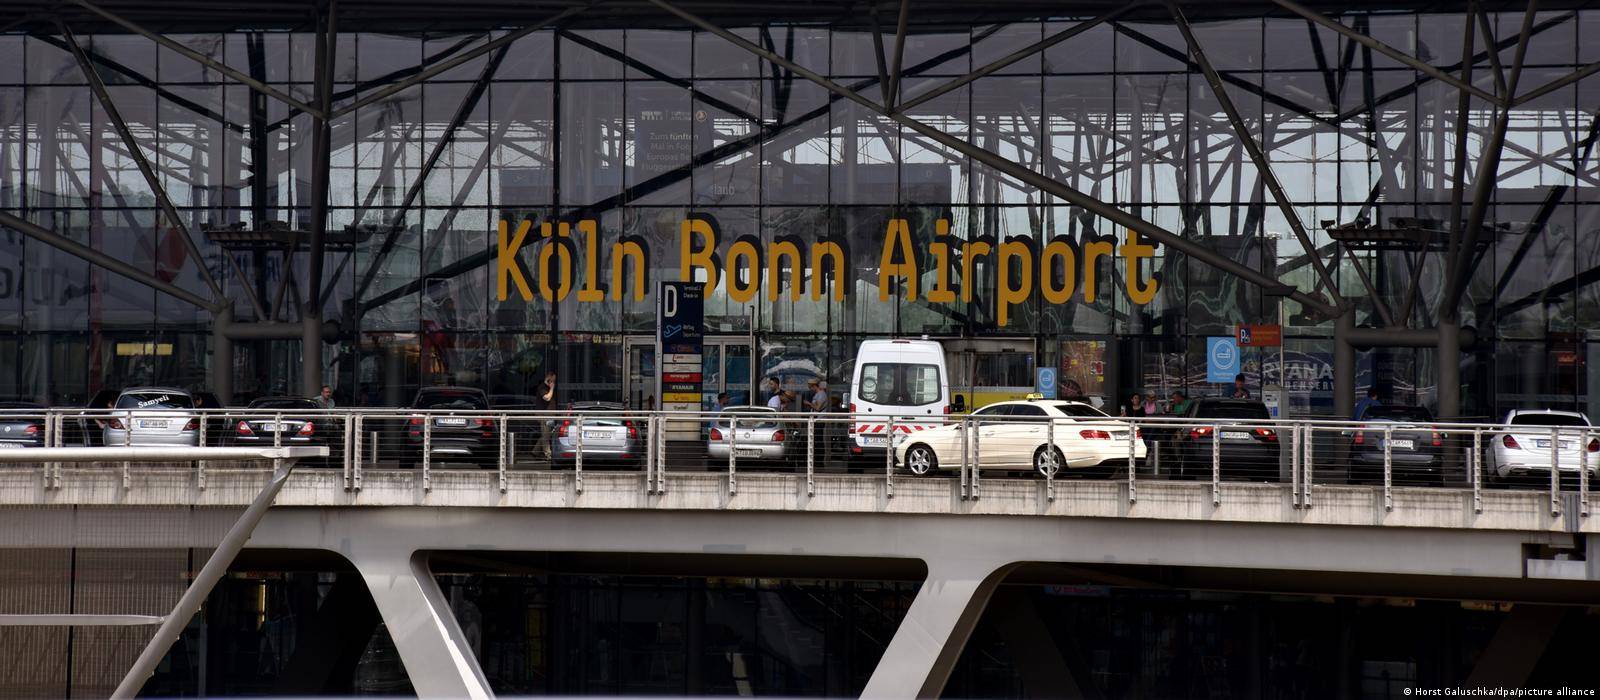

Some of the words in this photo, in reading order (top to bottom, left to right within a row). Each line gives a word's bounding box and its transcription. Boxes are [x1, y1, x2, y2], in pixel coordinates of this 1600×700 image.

[497, 220, 646, 302] Köln
[680, 219, 845, 303] Bonn
[879, 219, 1158, 327] Airport
[664, 284, 678, 317] D
